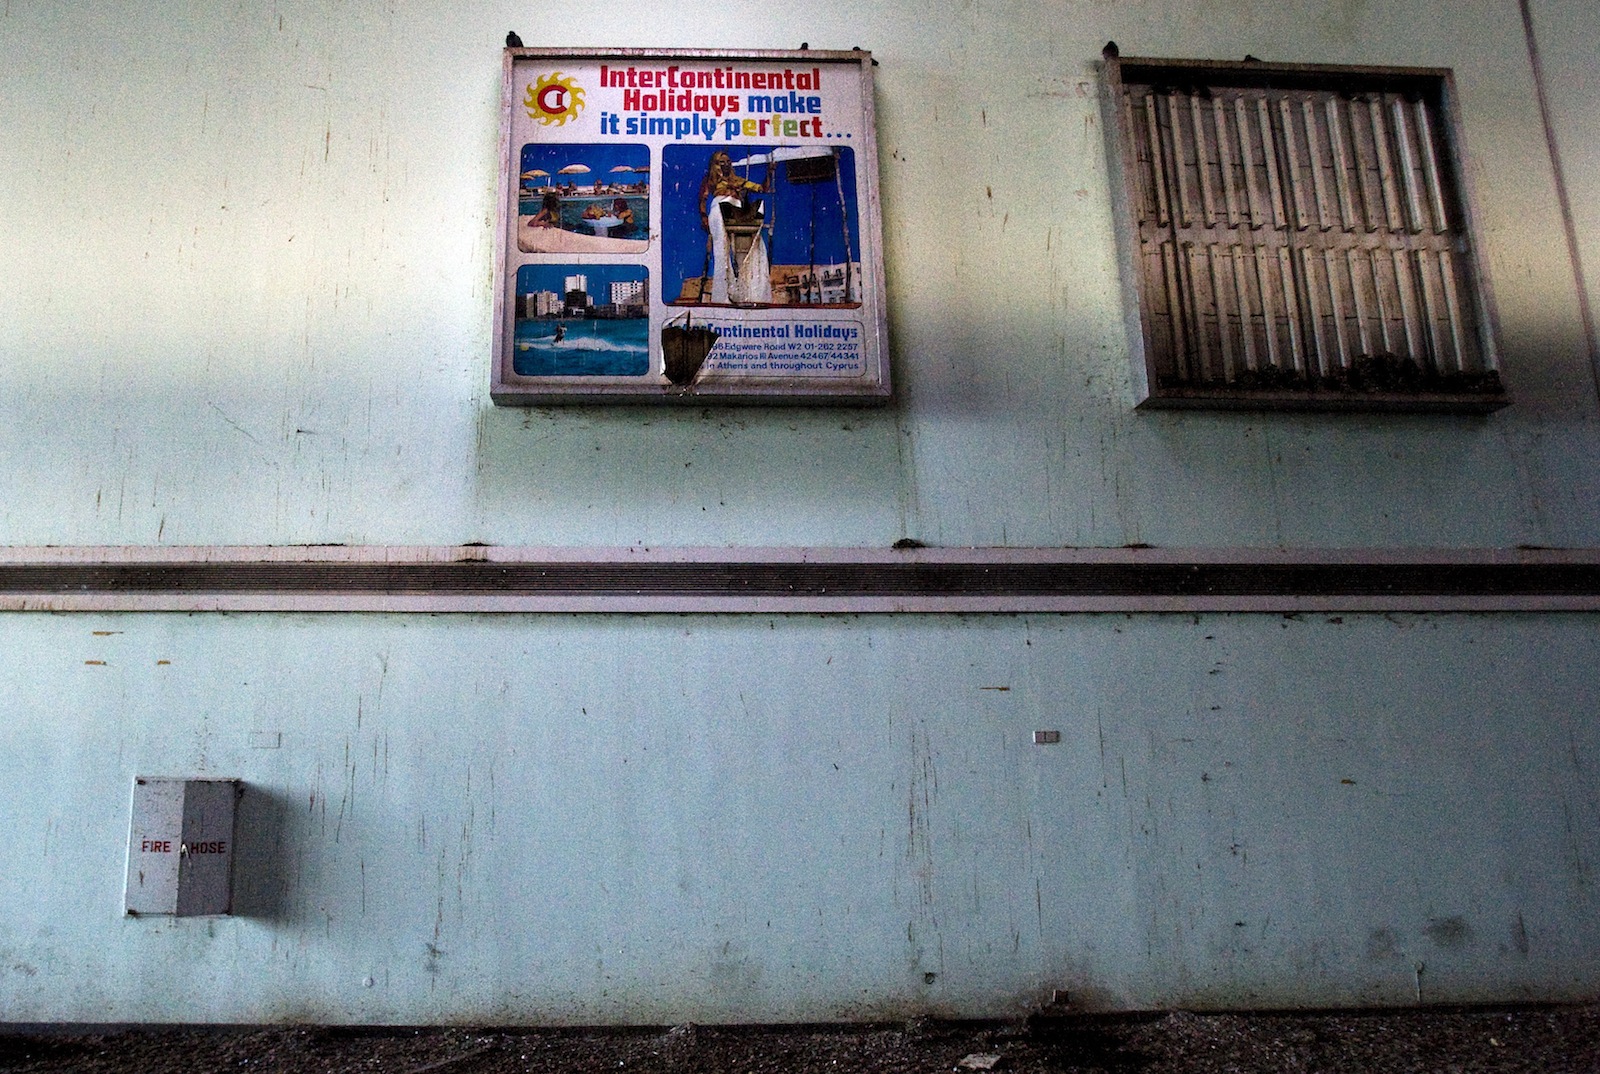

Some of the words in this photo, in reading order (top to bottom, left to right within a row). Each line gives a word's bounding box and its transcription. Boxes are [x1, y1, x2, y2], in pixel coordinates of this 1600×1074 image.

[600, 65, 820, 91] InterContinental
[623, 88, 740, 117] Holidays
[747, 92, 821, 114] make
[600, 112, 620, 135] it
[626, 112, 716, 141] simply
[794, 324, 858, 341] Holidays
[725, 343, 762, 352] Edgware
[717, 362, 749, 370] Athens
[751, 362, 768, 370] and
[770, 362, 823, 371] throughout
[825, 362, 859, 371] Cyprus
[142, 840, 171, 853] FIRE
[191, 841, 226, 854] HOSE
